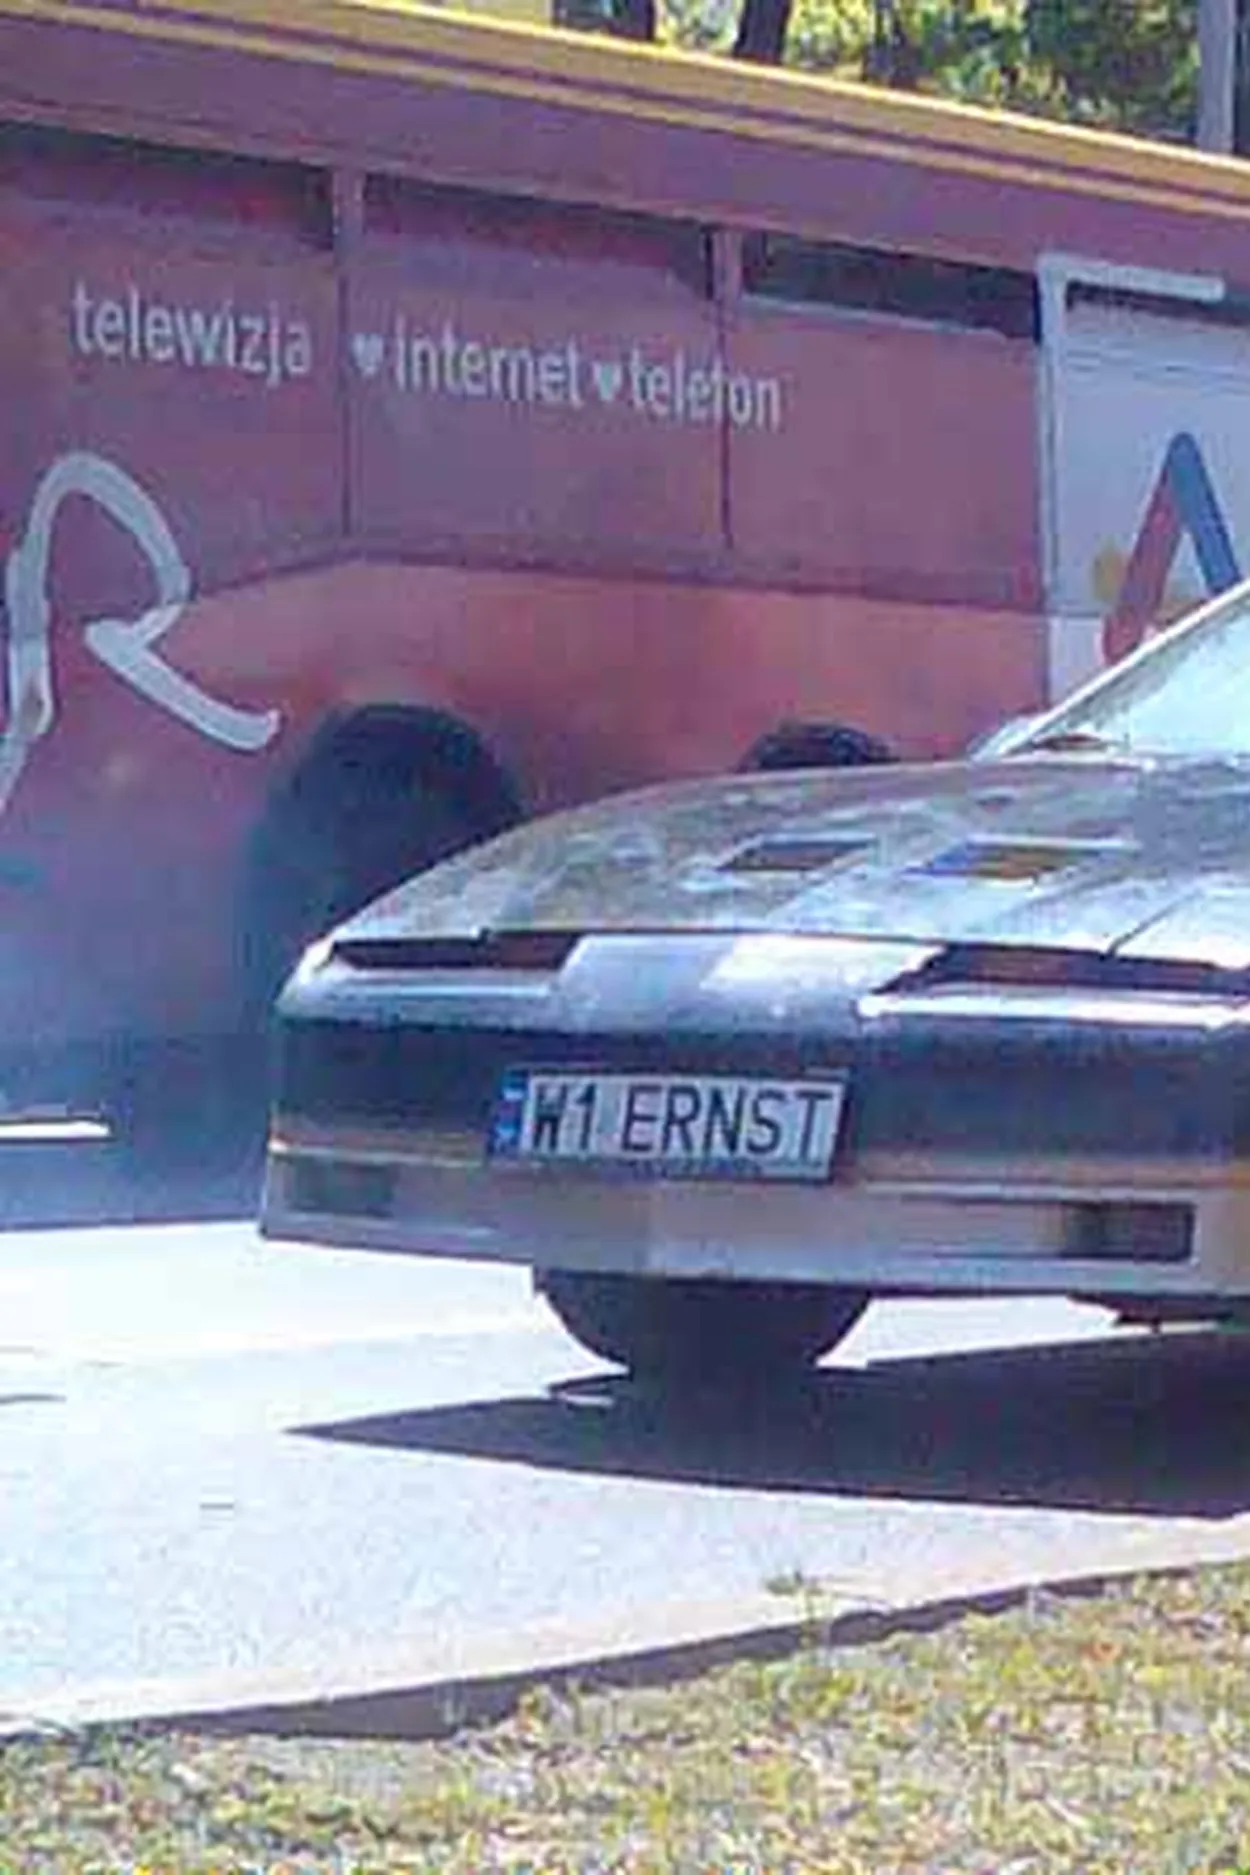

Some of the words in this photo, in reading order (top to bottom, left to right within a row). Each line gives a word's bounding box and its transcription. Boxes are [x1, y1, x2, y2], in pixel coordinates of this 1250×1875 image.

[72, 280, 313, 388] telewizja
[396, 314, 583, 406] internet
[631, 353, 784, 432] telefon
[621, 1084, 833, 1161] ERNST
